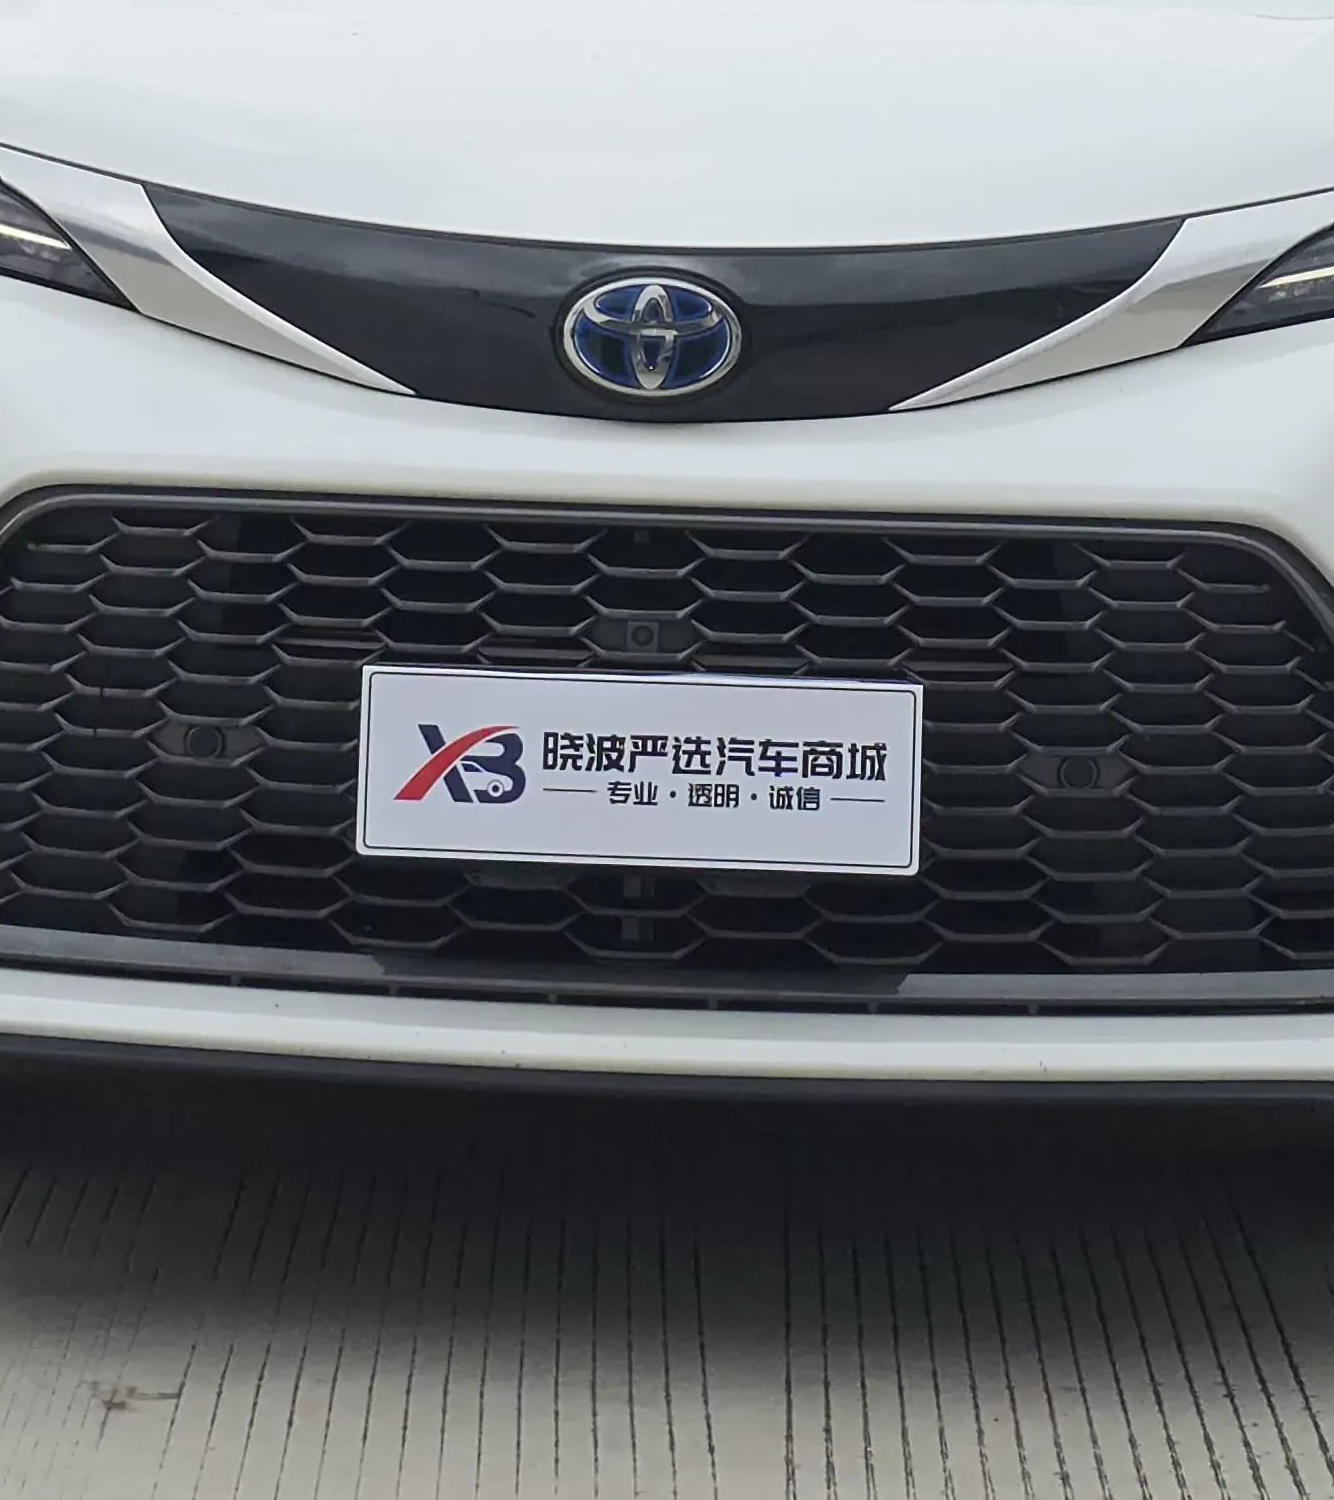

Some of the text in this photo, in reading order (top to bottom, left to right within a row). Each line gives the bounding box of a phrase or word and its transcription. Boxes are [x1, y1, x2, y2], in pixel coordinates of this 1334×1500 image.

[542, 730, 888, 782] 晓波严选汽车商城
